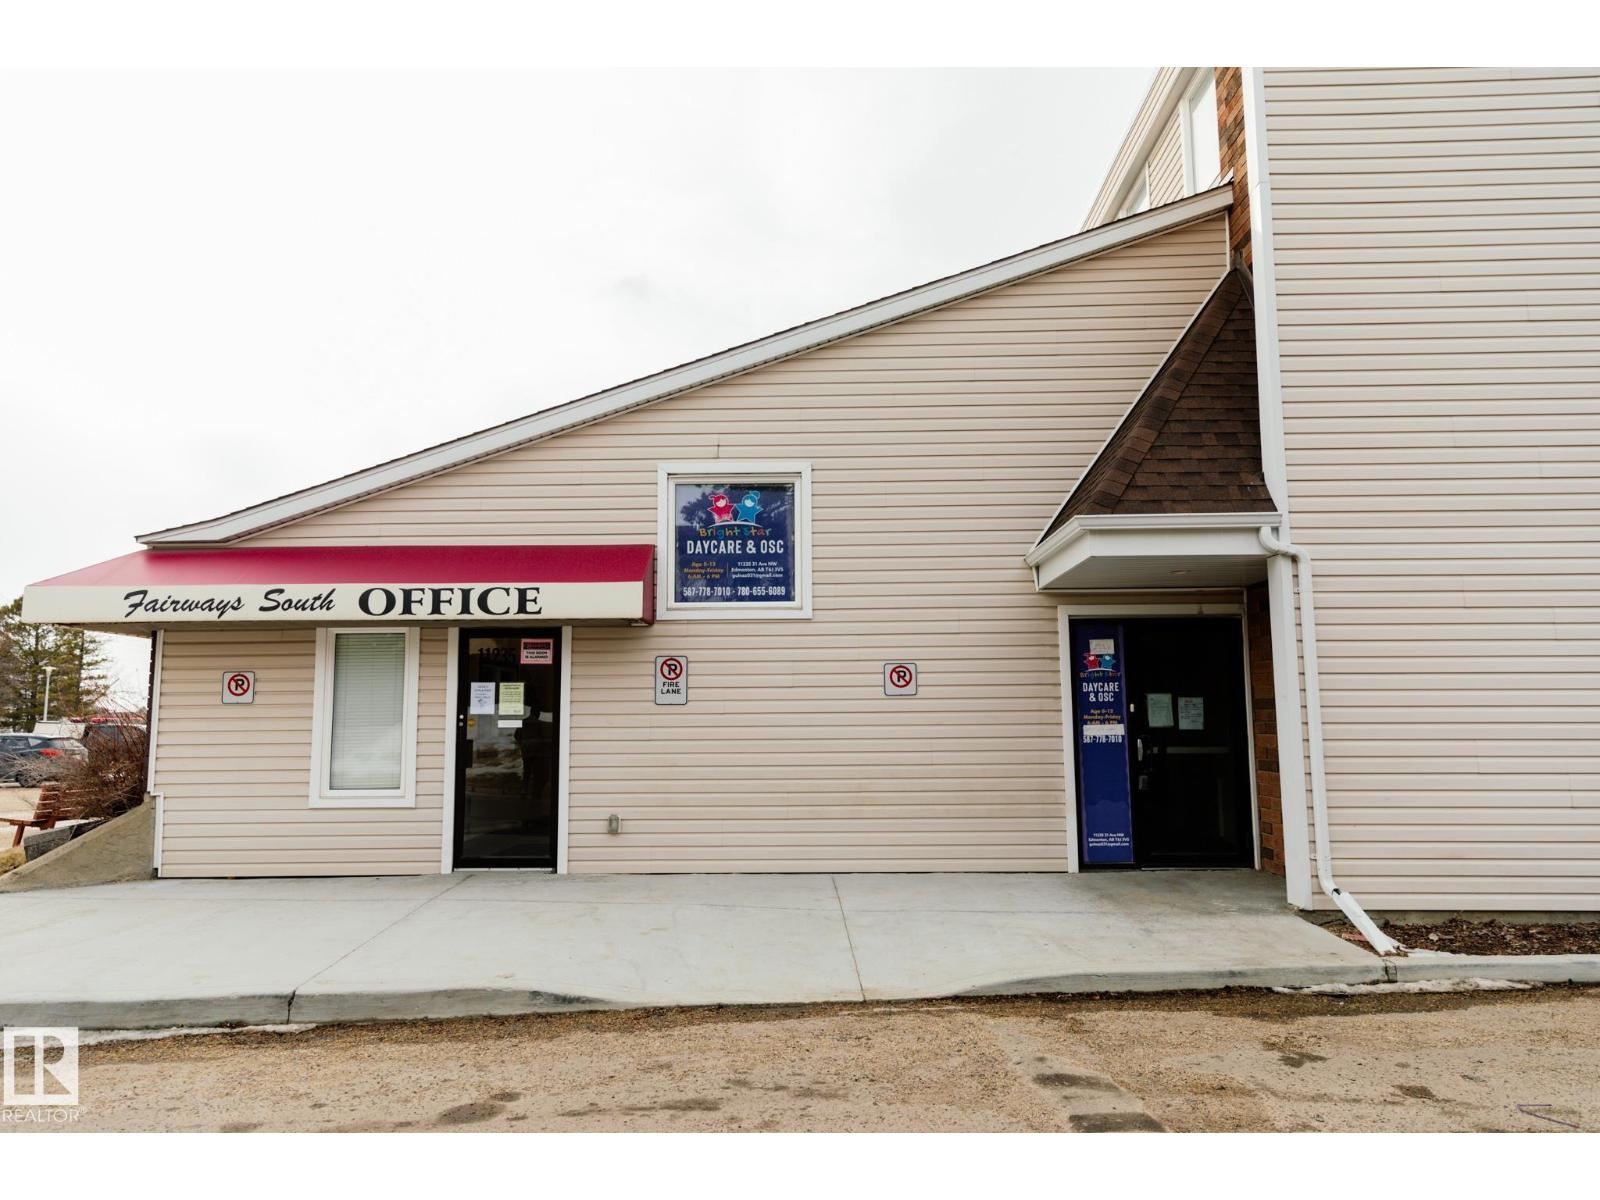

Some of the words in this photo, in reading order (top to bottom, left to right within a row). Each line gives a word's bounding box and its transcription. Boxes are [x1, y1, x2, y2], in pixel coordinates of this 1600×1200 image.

[699, 526, 740, 539] Bright
[743, 527, 772, 537] Star
[686, 540, 742, 554] DAYCARE
[746, 540, 757, 554] &
[760, 540, 784, 554] OSC
[683, 586, 731, 597] 587-778-7010
[737, 586, 786, 596] 780-655-6089
[123, 589, 245, 619] Fairways
[258, 588, 336, 612] South
[358, 586, 542, 616] OFFICE
[1082, 682, 1120, 692] DAYCARE
[1088, 692, 1097, 702] &
[1098, 692, 1114, 702] OSC
